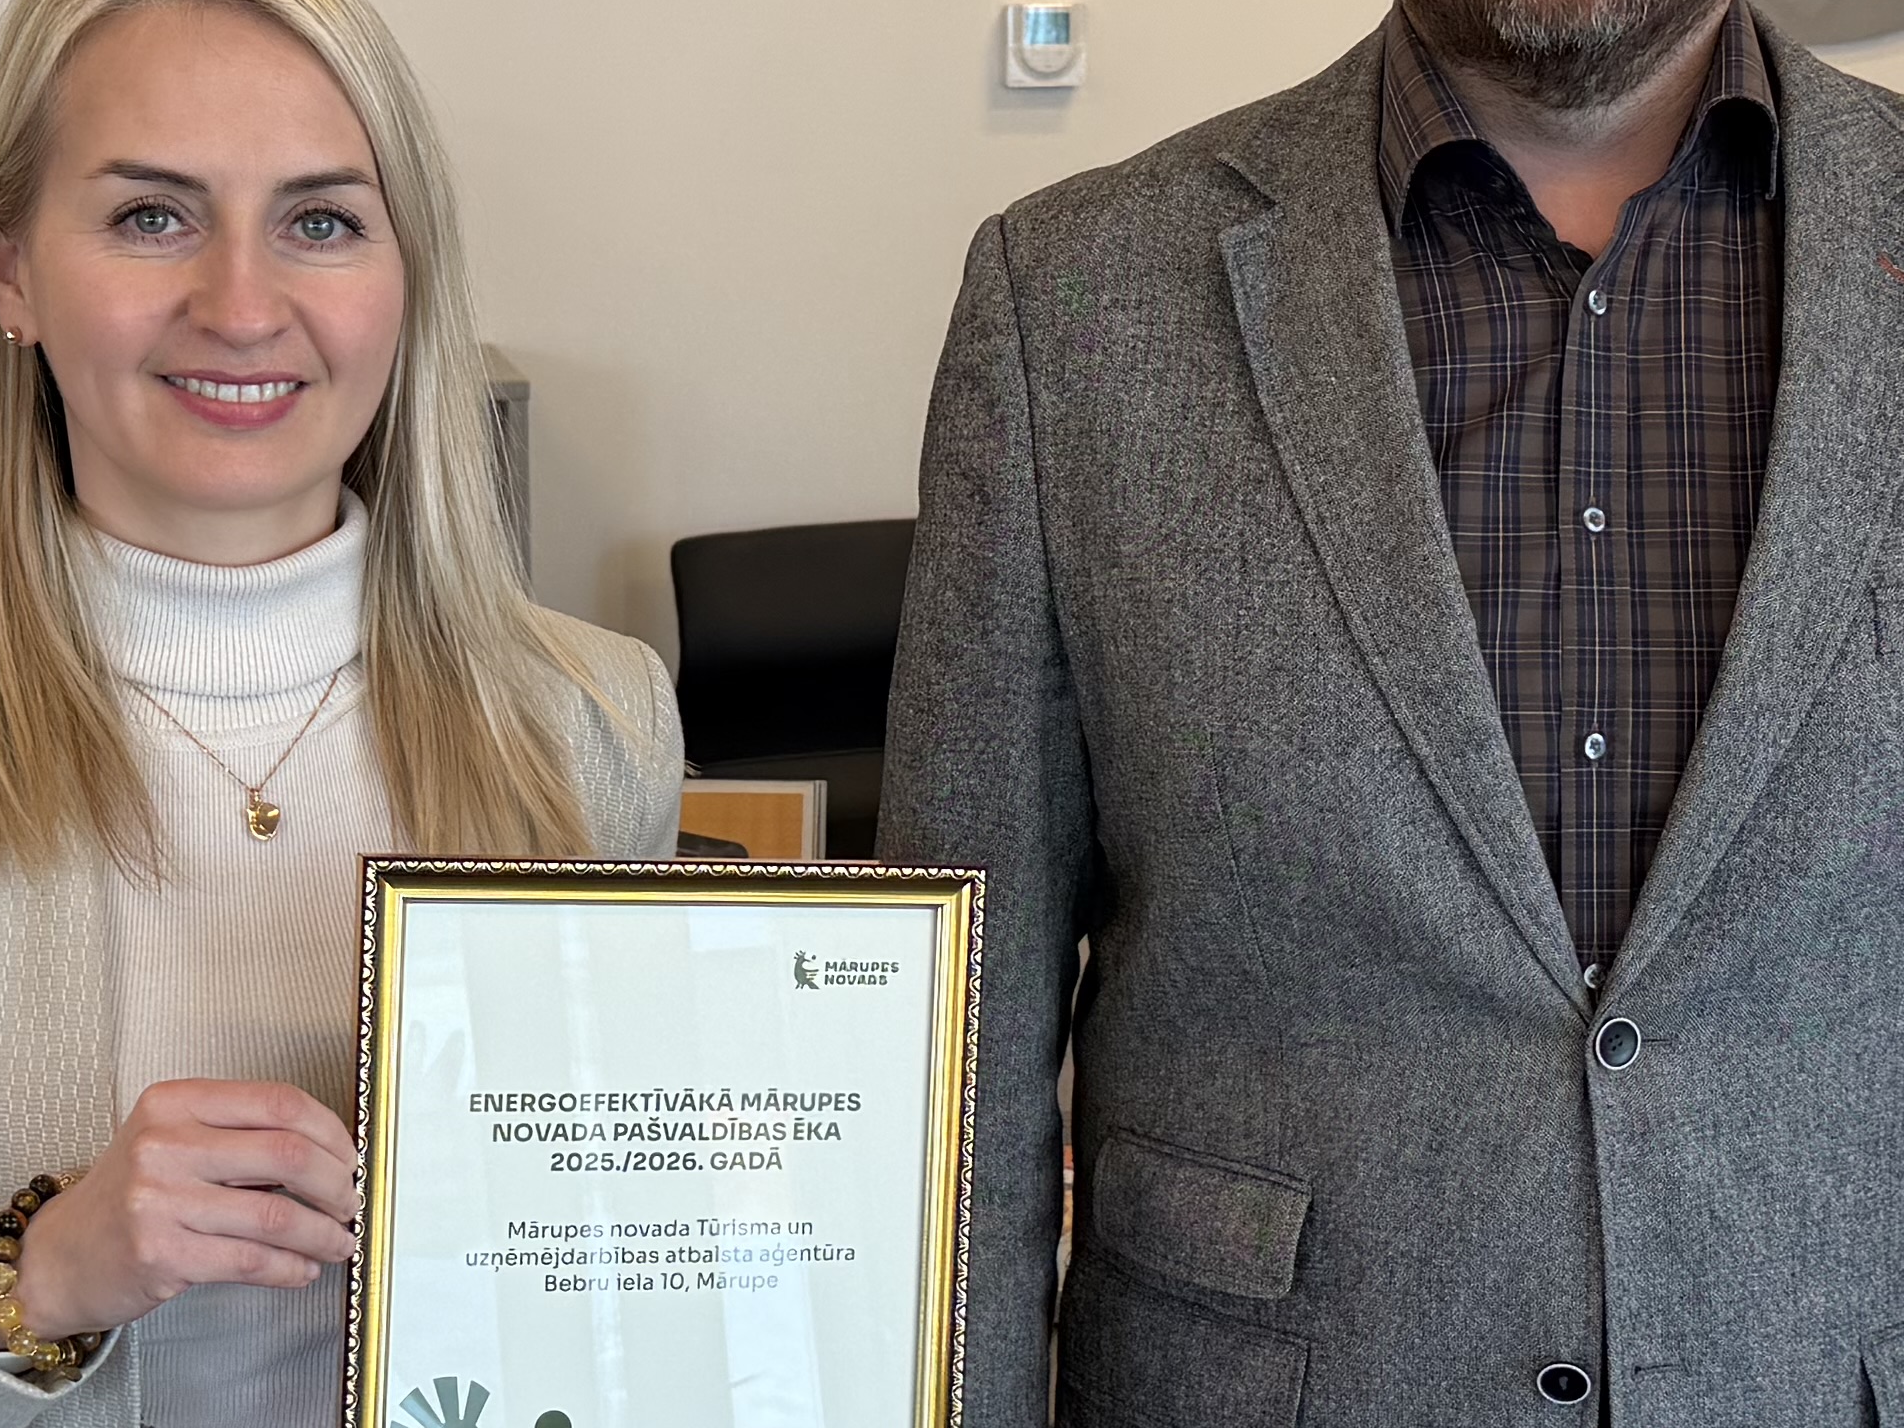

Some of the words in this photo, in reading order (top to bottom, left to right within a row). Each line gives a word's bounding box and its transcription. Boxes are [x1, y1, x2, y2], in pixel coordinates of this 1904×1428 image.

[824, 959, 900, 973] MĀRUPES
[824, 974, 888, 986] NOVADS
[469, 1089, 734, 1114] ENERGOEFEKTĪVĀKĀ
[740, 1089, 862, 1112] MĀRUPES
[492, 1123, 608, 1143] NOVADA
[613, 1118, 787, 1143] PAŠVALDĪBAS
[792, 1118, 842, 1142] ĒKA
[550, 1151, 704, 1173] 2025./2026.
[710, 1148, 783, 1171] GADĀ
[508, 1220, 604, 1244] Mārupes
[610, 1220, 691, 1238] novada
[697, 1218, 782, 1238] Tūrisma
[787, 1221, 814, 1237] un
[465, 1245, 660, 1271] uzņēmējdarbības
[665, 1245, 753, 1264] atbalsta
[758, 1241, 856, 1267] aģentūra
[544, 1273, 609, 1292] Bebru
[616, 1272, 654, 1292] iela
[661, 1272, 691, 1296] 10,
[696, 1271, 778, 1295] Mārupe
